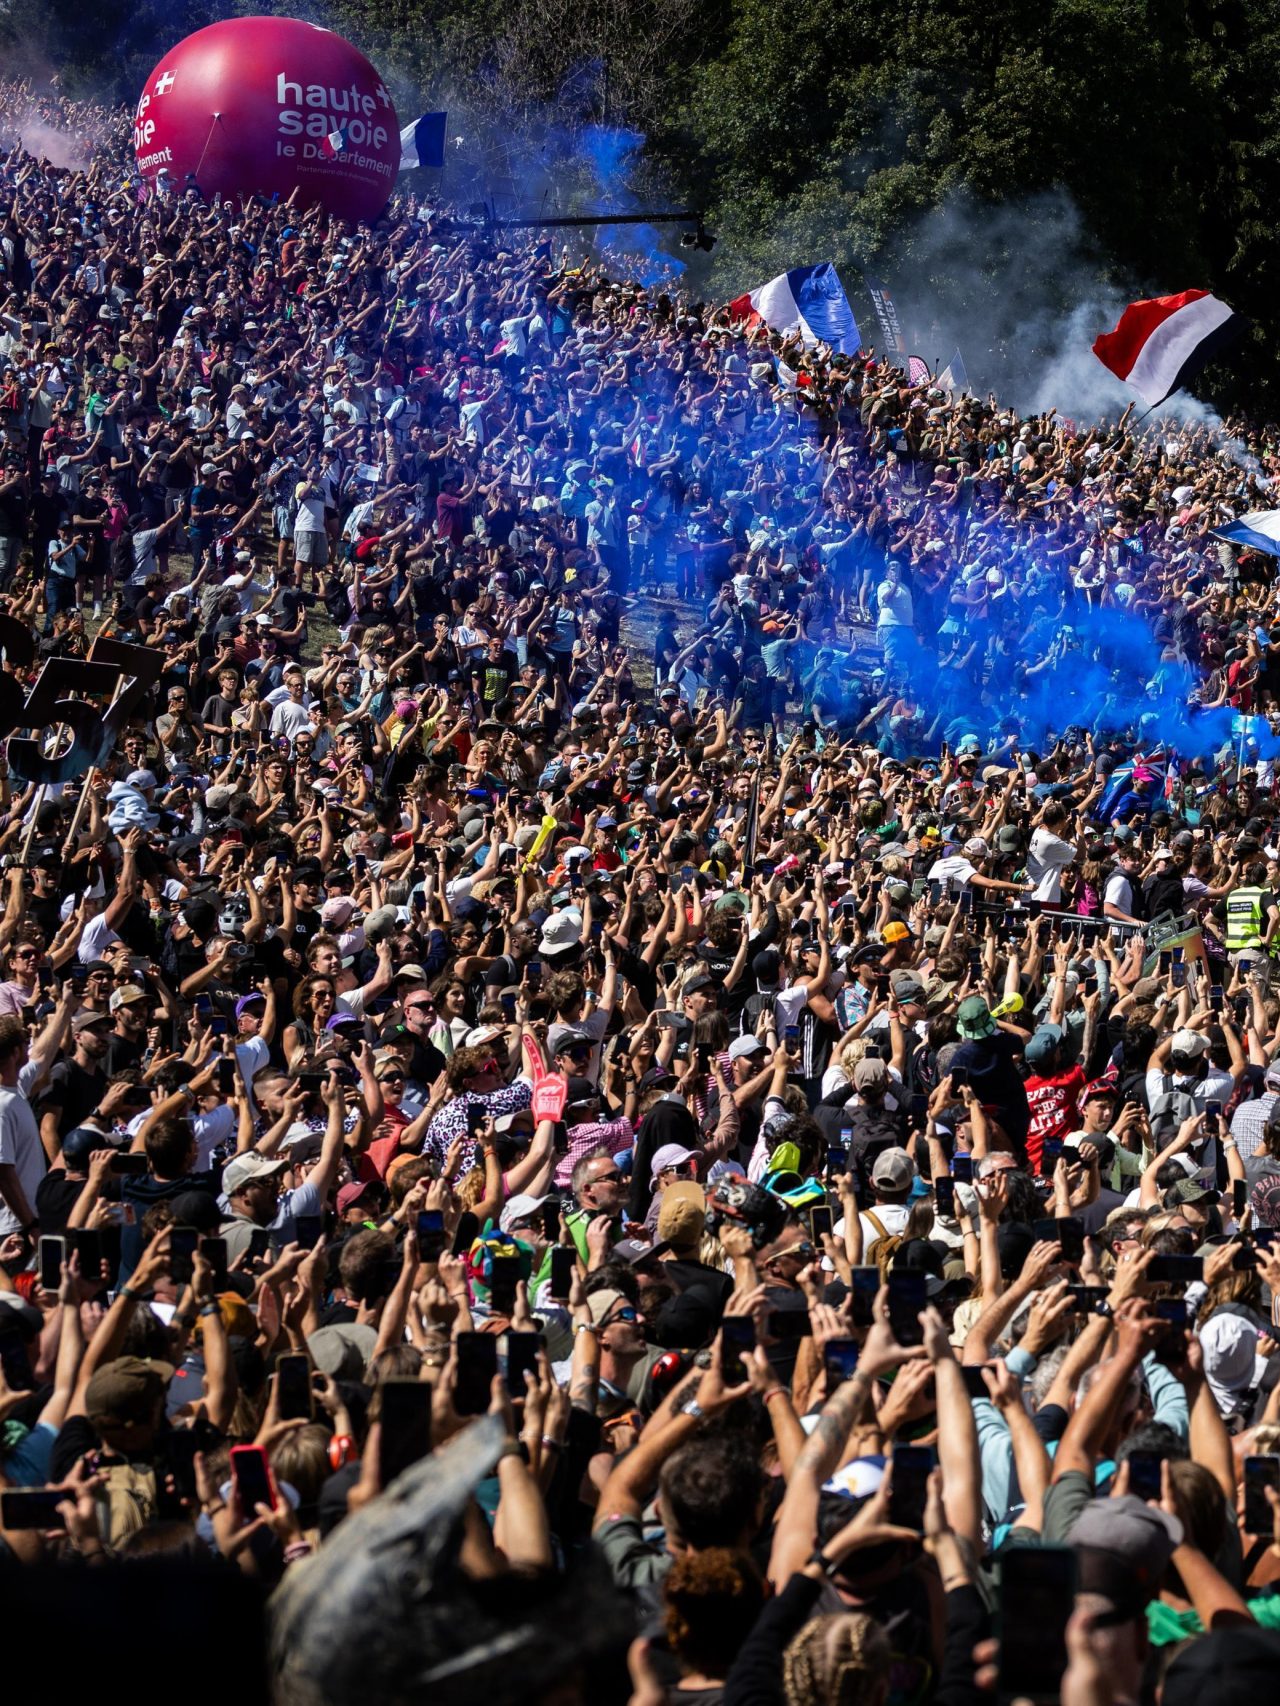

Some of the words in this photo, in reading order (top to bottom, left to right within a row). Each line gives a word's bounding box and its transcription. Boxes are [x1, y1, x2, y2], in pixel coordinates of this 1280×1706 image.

[277, 72, 376, 117] haute
[278, 111, 387, 149] savoie
[277, 141, 296, 156] le
[870, 288, 886, 316] FREE
[883, 300, 902, 334] RACES
[880, 318, 898, 352] TRASH
[1034, 1099, 1058, 1114] THE
